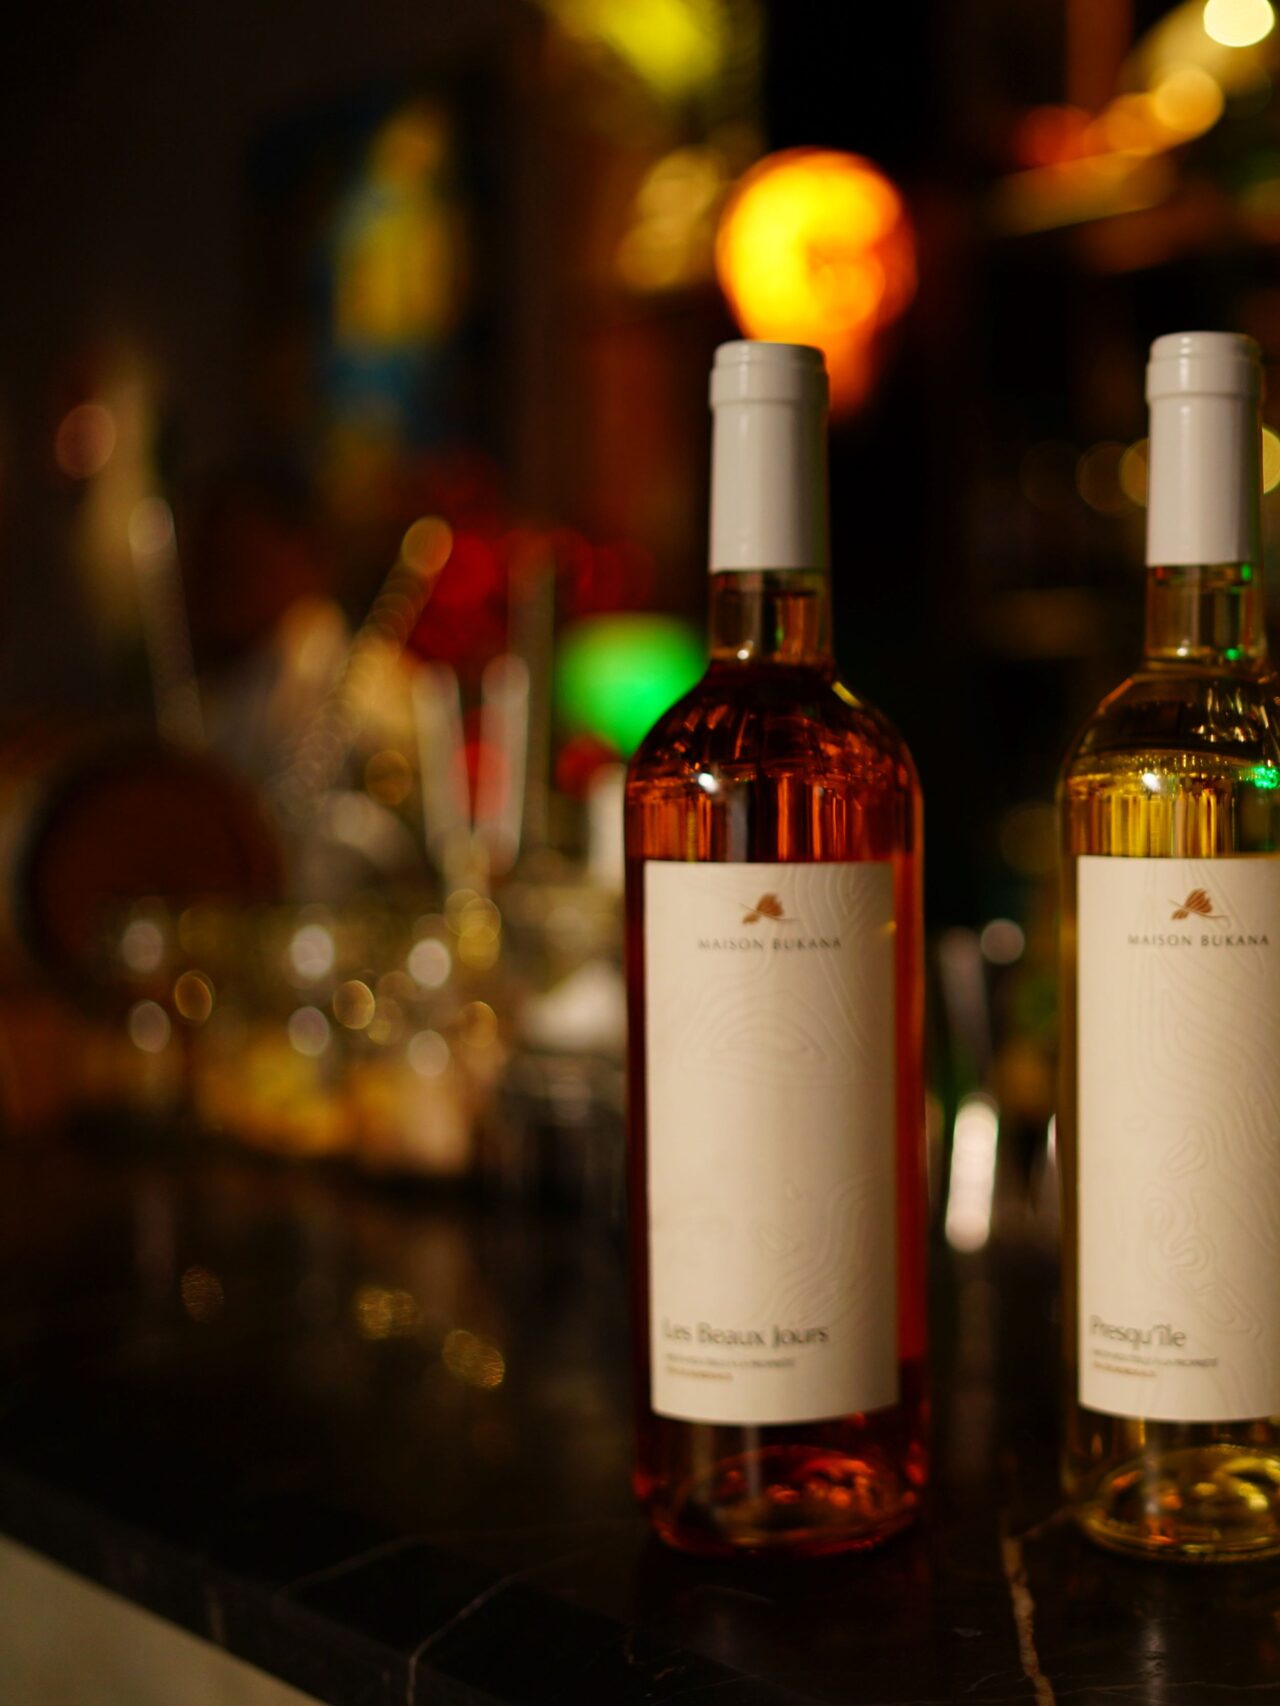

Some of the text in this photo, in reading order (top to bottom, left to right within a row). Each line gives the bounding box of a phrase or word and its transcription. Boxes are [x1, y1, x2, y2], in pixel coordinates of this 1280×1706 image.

[698, 937, 842, 950] MAISON BUKANA
[1127, 934, 1270, 947] MAISON BUKANA
[663, 1317, 829, 1349] Les Beaux Jours
